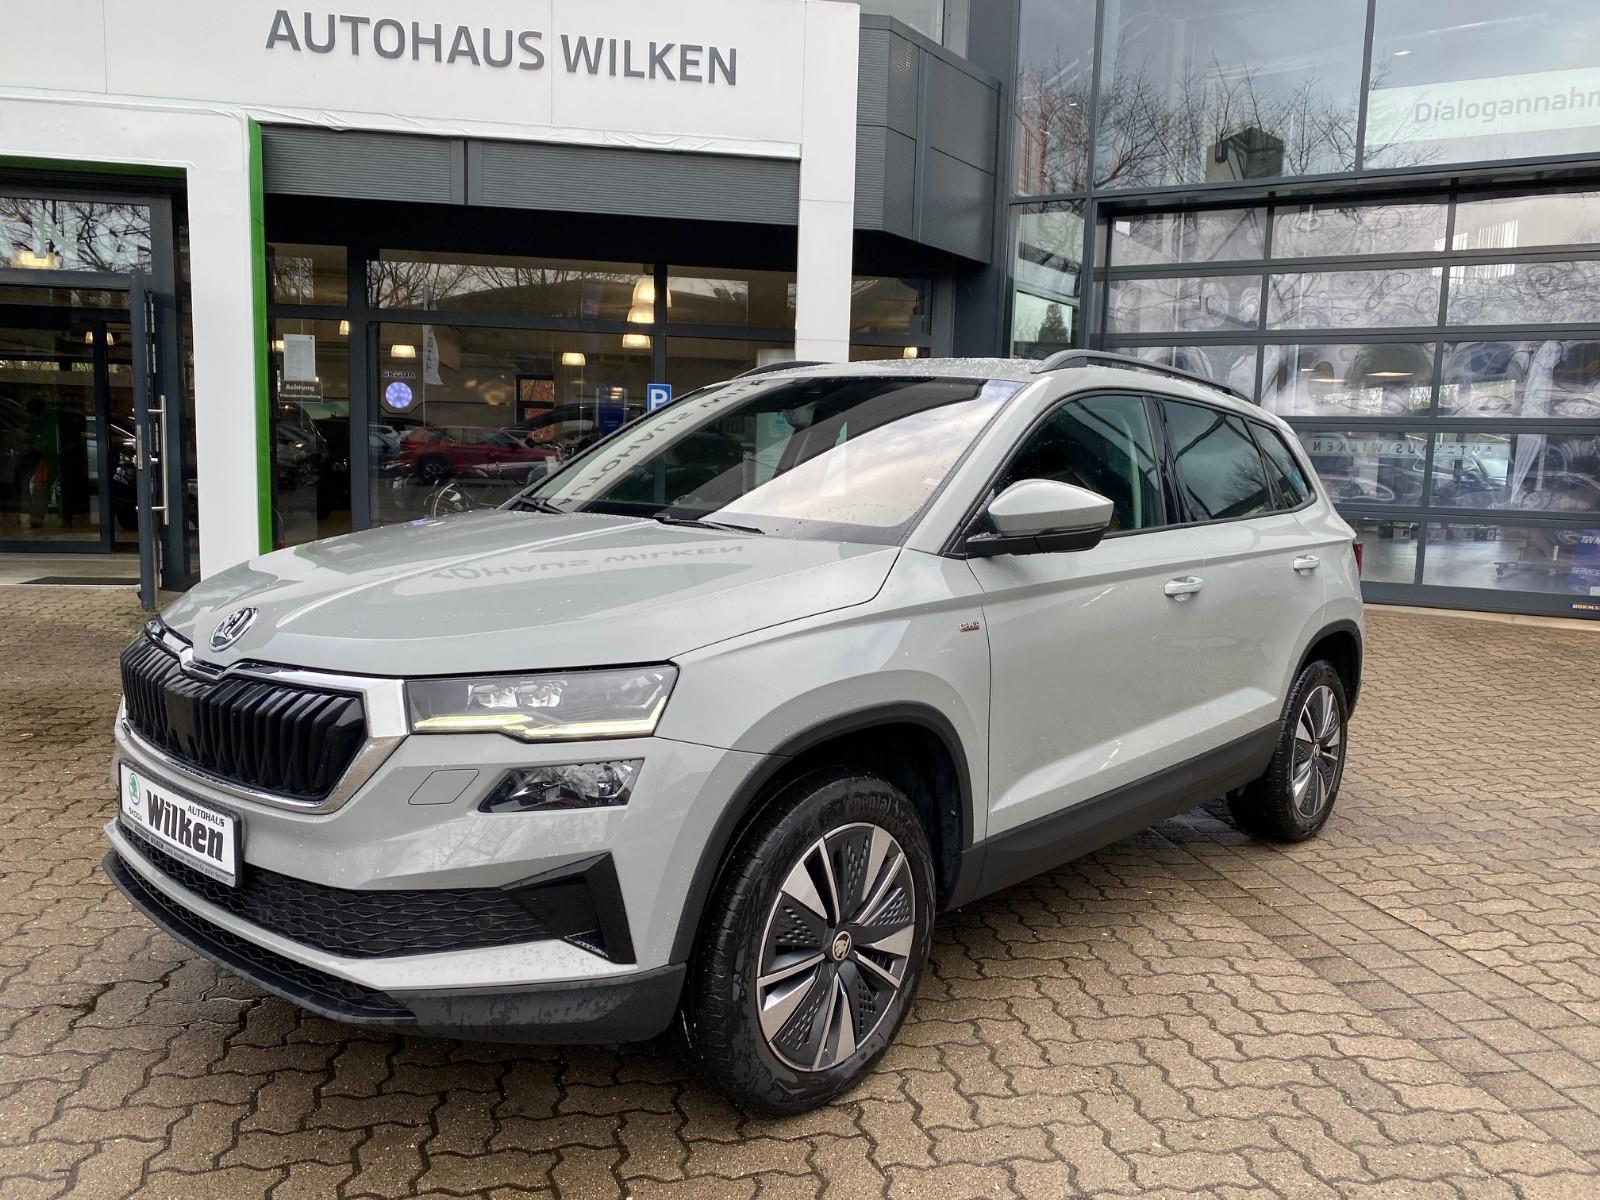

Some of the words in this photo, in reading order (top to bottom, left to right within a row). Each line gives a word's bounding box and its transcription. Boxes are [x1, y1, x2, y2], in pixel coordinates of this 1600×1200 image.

[265, 9, 545, 71] AUTOHAUS
[560, 33, 737, 86] WILKEN
[285, 383, 315, 393] Achtung
[650, 388, 669, 411] P
[146, 789, 224, 862] Wilken
[186, 805, 225, 827] AUTOHAUS
